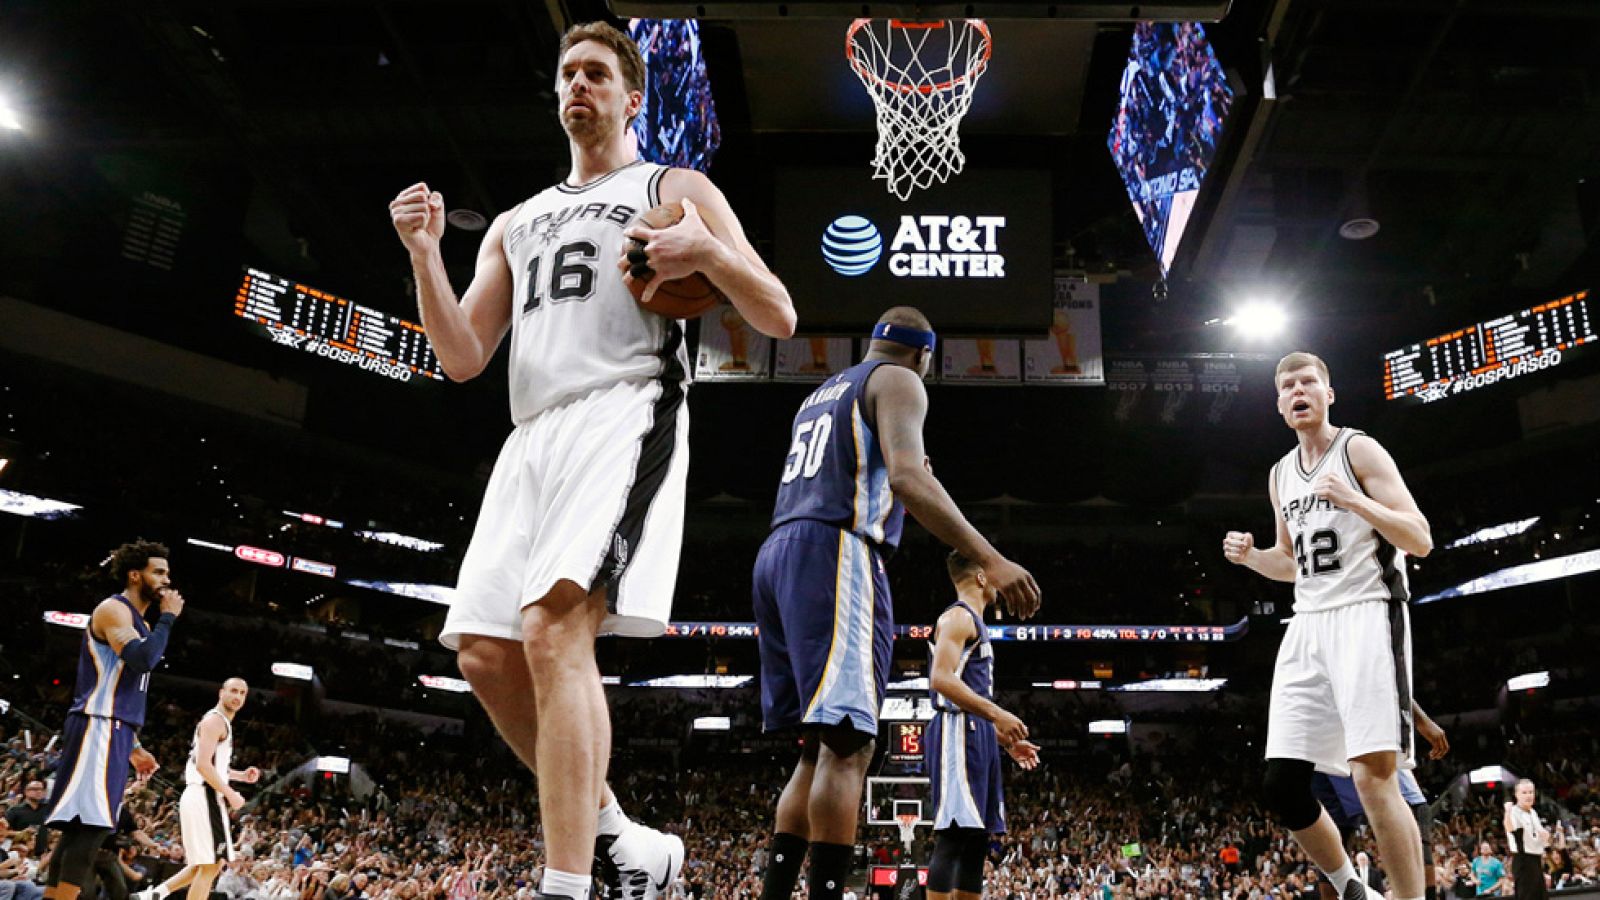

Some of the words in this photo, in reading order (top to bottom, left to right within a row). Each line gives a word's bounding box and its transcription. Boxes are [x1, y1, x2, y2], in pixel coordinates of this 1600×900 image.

[508, 202, 637, 254] SPURS
[890, 215, 1006, 252] AT&T
[521, 239, 601, 319] 16
[888, 252, 1005, 277] CENTER
[1054, 300, 1094, 309] MPIONS
[305, 339, 412, 382] #GOSPURSGO
[1452, 350, 1562, 394] #GOSPURSGO
[1153, 383, 1194, 391] 2013
[1201, 383, 1240, 392] 2014
[781, 412, 832, 483] 50
[1294, 528, 1344, 578] 42
[1016, 626, 1036, 640] 61
[1063, 628, 1072, 638] 3
[1119, 628, 1138, 639] TOL
[902, 735, 918, 752] 15
